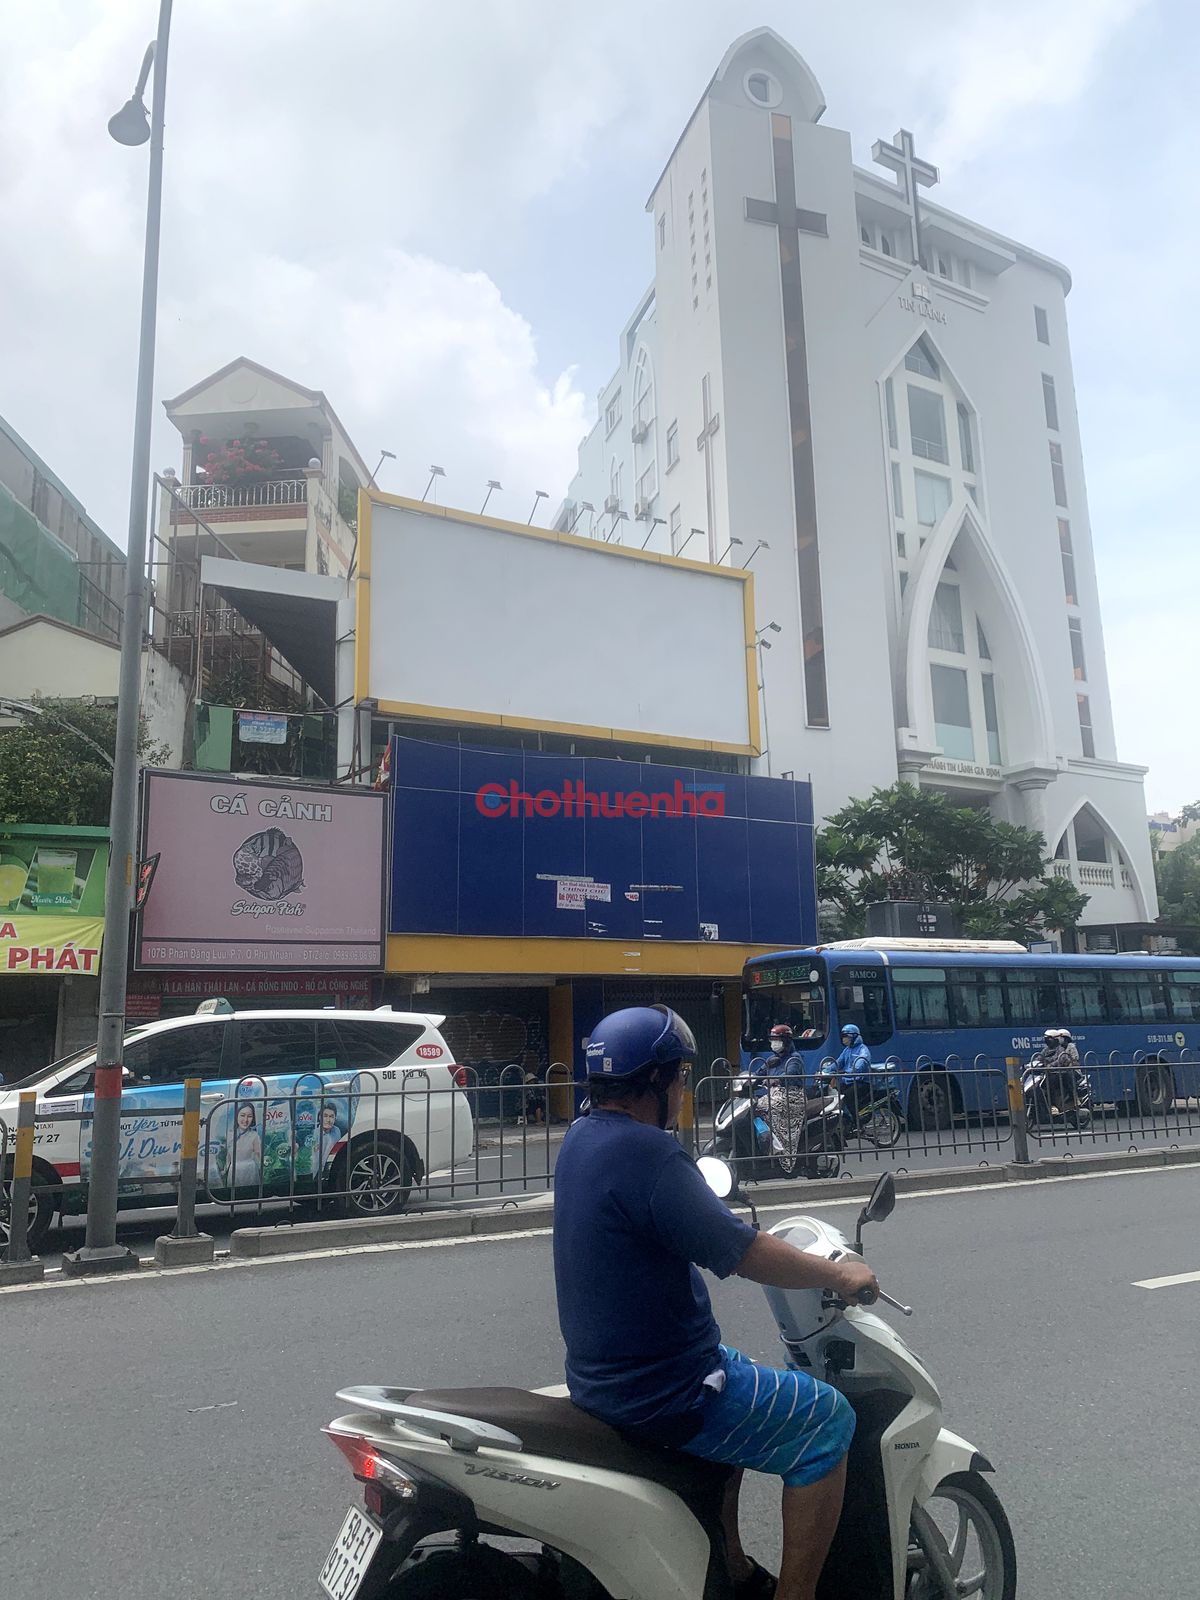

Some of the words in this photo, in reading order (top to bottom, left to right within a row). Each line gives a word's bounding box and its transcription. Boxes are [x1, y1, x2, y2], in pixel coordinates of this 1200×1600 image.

[210, 793, 249, 815] CÁ
[258, 795, 333, 822] CẢNH
[231, 900, 275, 918] Saigon
[276, 901, 304, 916] Fish
[8, 943, 98, 971] PHÁT
[849, 970, 877, 979] SAMCO
[171, 981, 182, 992] LA
[224, 980, 240, 992] LAN
[281, 981, 299, 992] INDO
[1011, 1037, 1031, 1049] CNG
[419, 1047, 441, 1057] 18589
[382, 1070, 396, 1080] 50E
[46, 1133, 60, 1143] 27
[894, 1441, 920, 1450] HONDA
[342, 1513, 375, 1565] 59-E1
